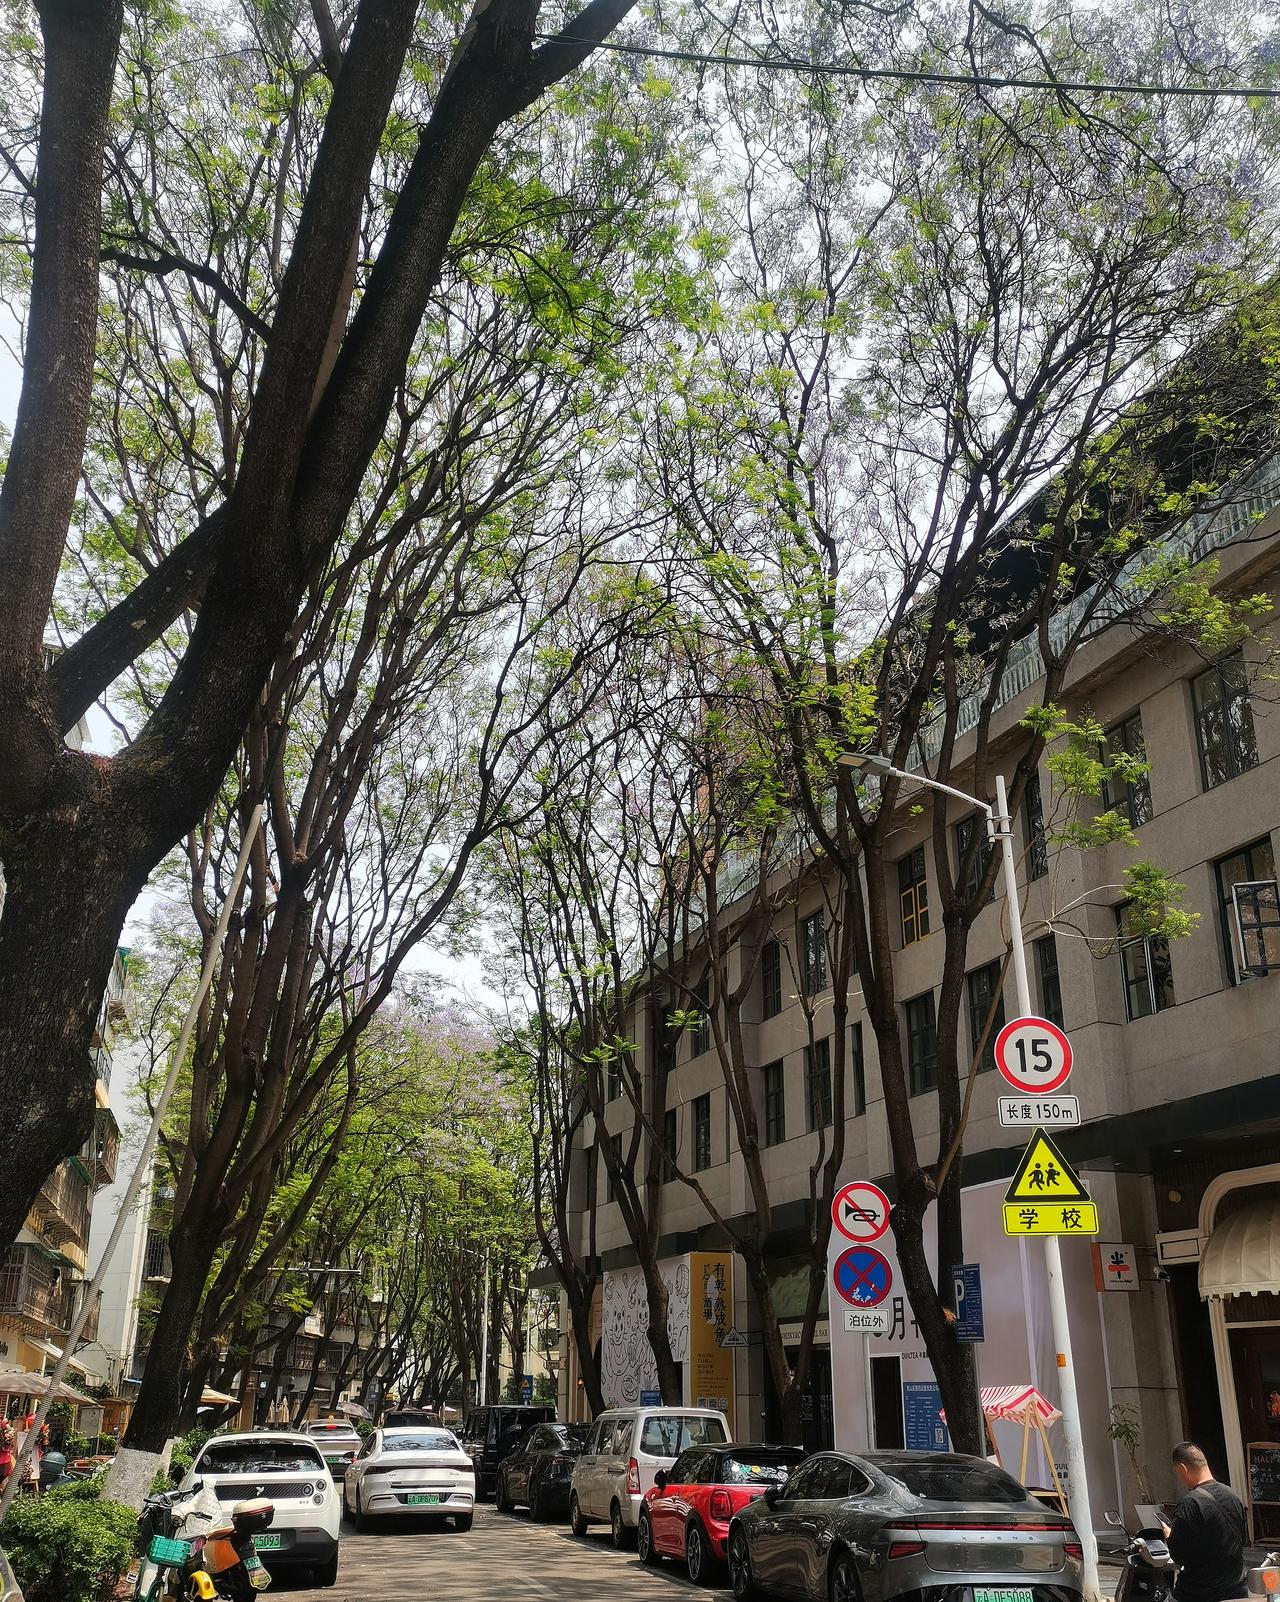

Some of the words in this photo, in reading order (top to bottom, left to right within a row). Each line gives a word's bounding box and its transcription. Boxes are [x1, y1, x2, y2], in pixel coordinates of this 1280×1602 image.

[1015, 1038, 1053, 1072] 15
[849, 1315, 884, 1328] 泊位外
